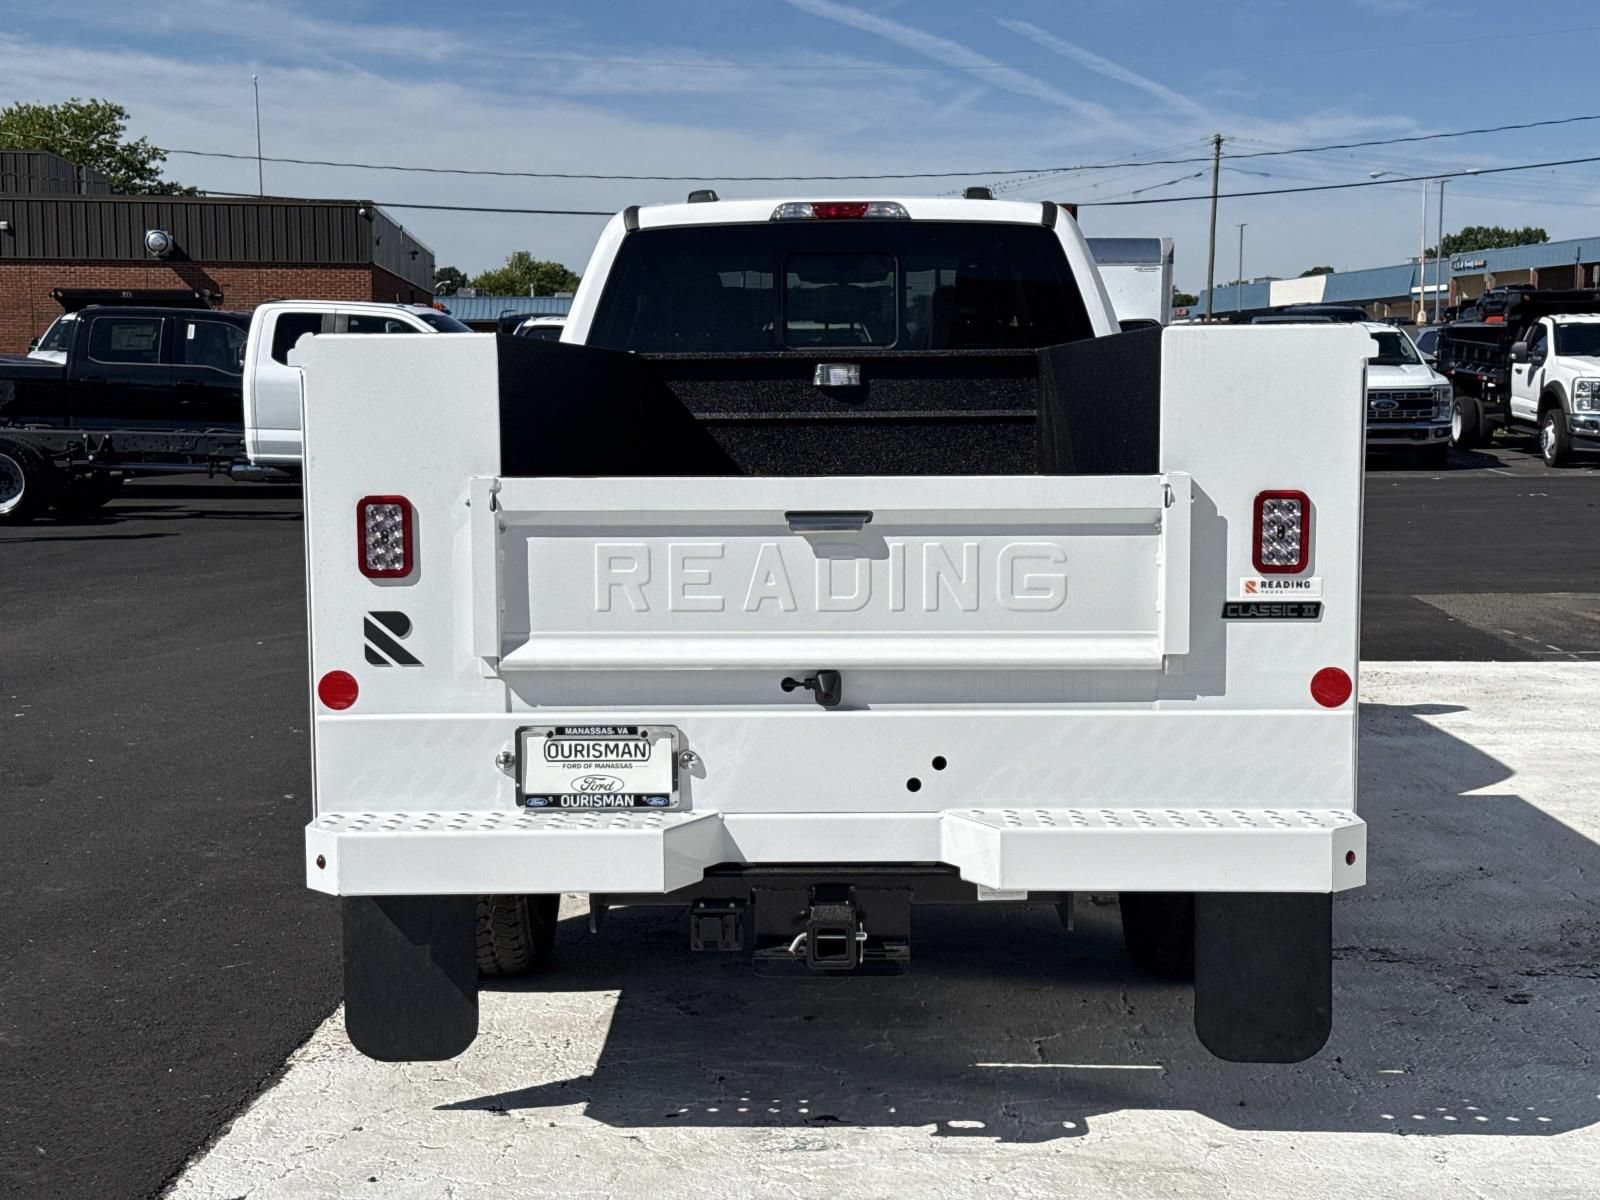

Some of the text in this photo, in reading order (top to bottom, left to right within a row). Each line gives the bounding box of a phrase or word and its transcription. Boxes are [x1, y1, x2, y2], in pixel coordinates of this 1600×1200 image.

[594, 542, 1068, 612] READING
[1226, 604, 1298, 616] CLASSIC
[617, 727, 629, 735] VA
[547, 743, 647, 759] OURISMAN
[580, 777, 615, 792] Ford
[560, 795, 635, 807] OURISMAN
